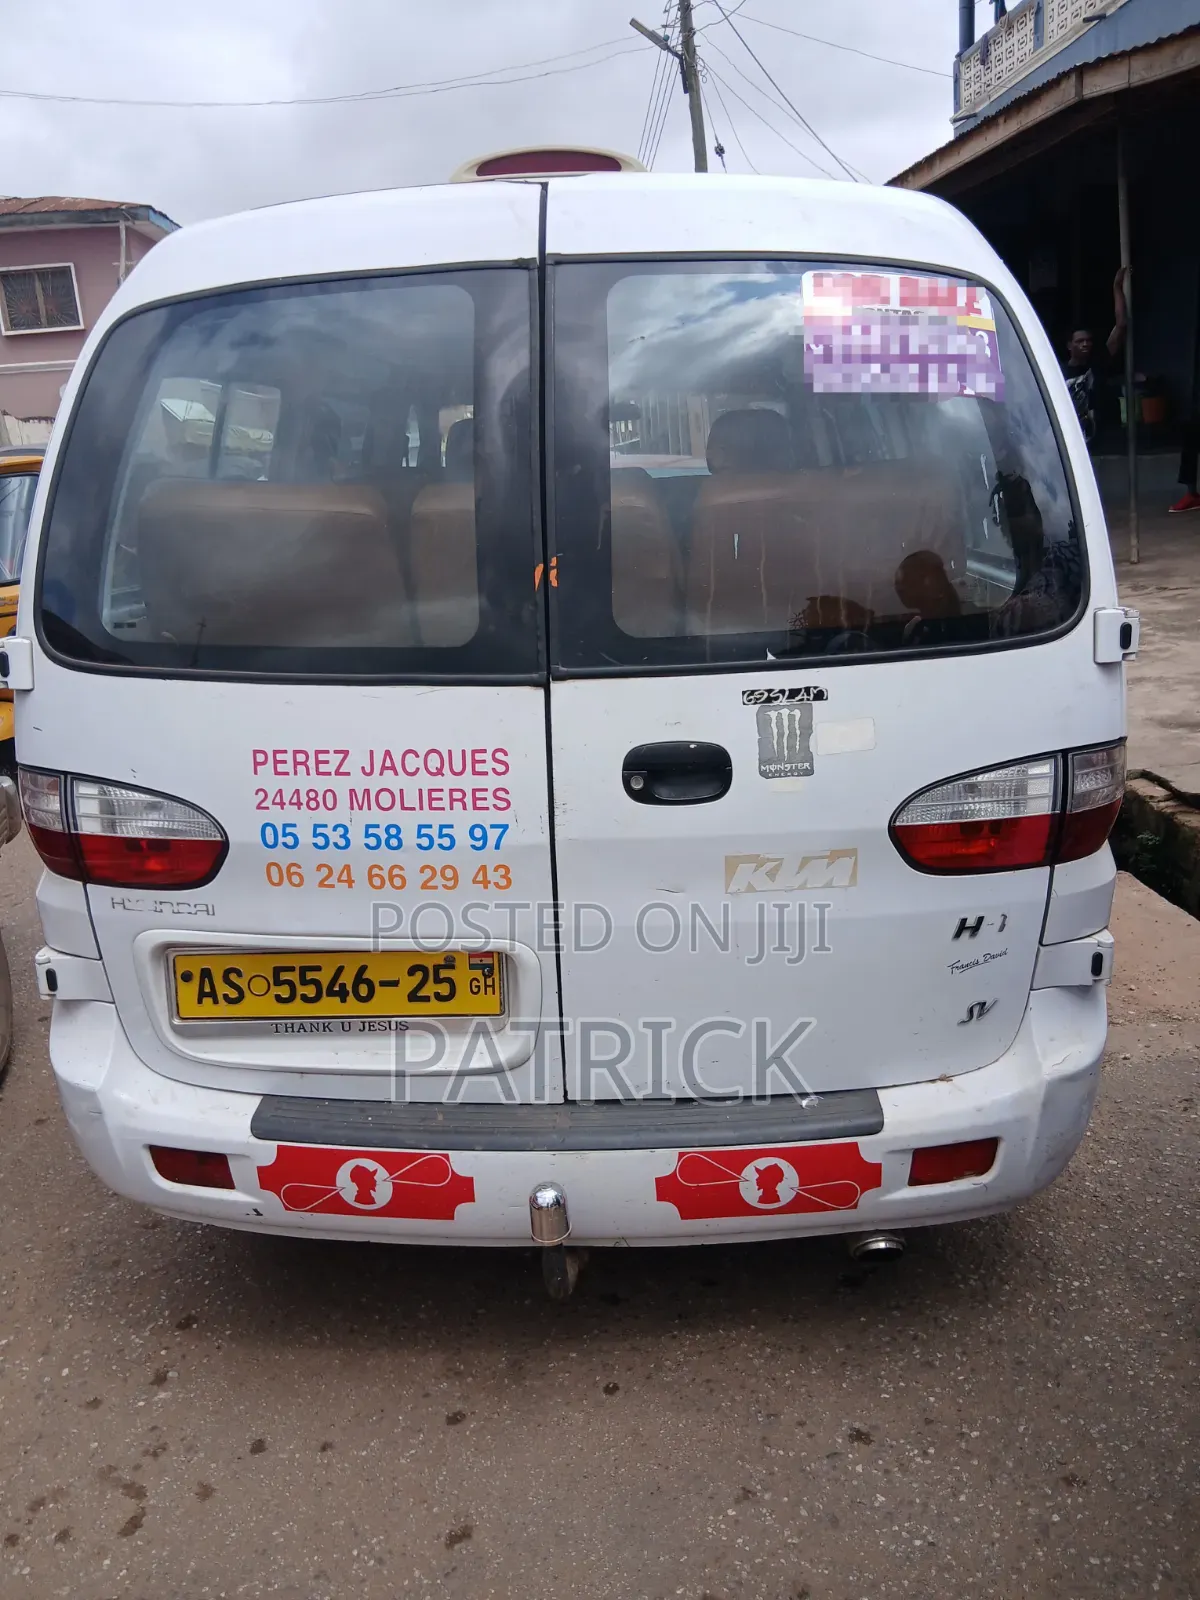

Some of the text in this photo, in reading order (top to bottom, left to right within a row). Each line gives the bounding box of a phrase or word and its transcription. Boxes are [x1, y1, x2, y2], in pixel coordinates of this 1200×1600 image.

[252, 748, 510, 777] PEREZ JACQUES
[760, 762, 811, 772] MONSTER
[255, 788, 511, 812] 24480 MOLIERES
[260, 822, 510, 851] 05 53 58 55 97
[265, 862, 513, 890] 06 24 66 29 43
[947, 947, 1008, 975] Francis David
[197, 964, 457, 1004] AS 5546-25
[469, 976, 496, 996] GH
[271, 1019, 410, 1034] THANK U JESUS
